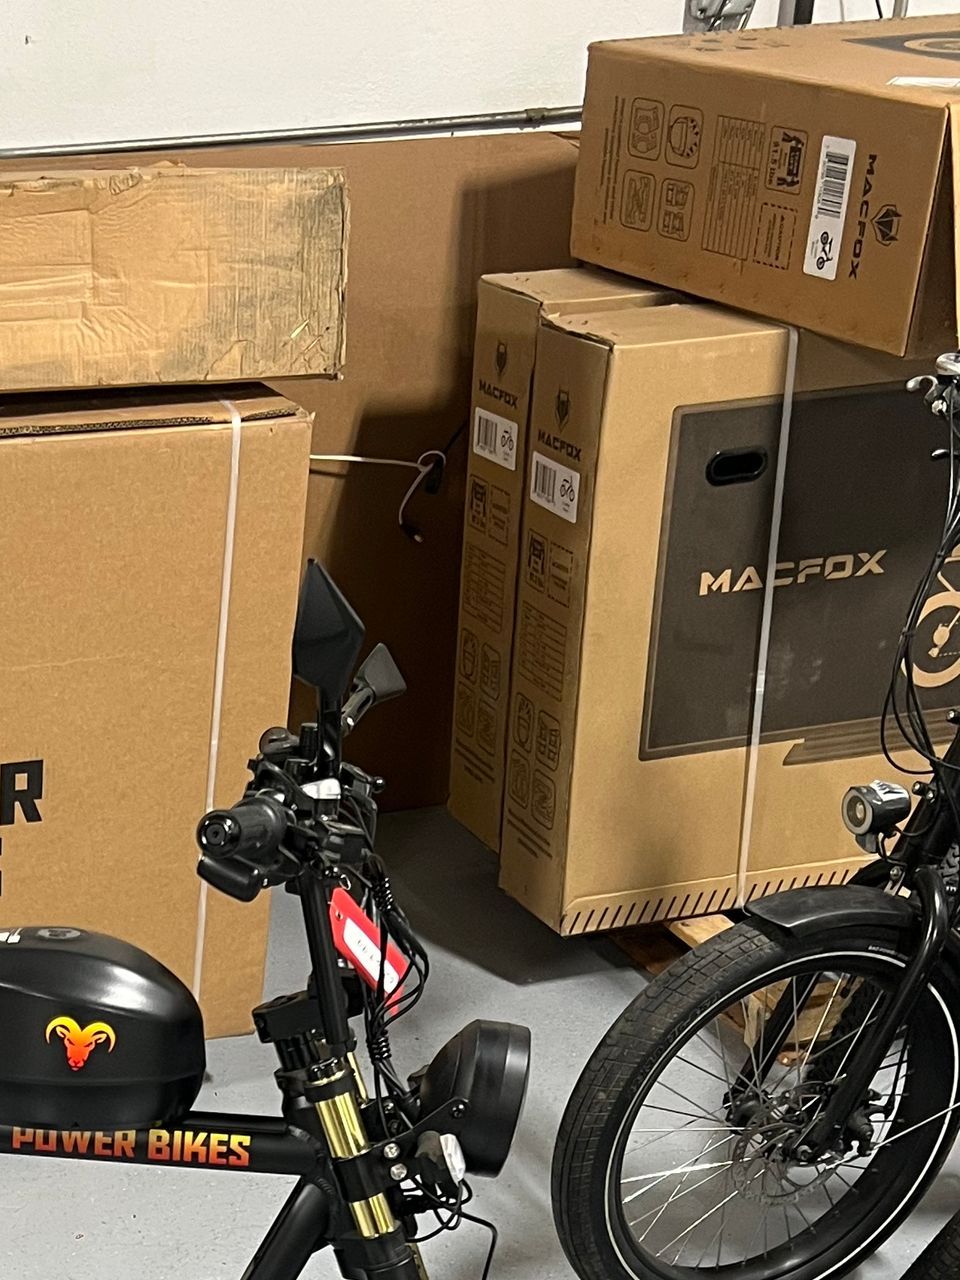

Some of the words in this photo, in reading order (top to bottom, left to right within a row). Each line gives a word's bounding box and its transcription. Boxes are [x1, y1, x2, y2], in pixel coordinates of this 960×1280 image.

[848, 154, 878, 280] MACFOX
[478, 379, 519, 409] MACFOX
[537, 428, 582, 462] MACFOX
[698, 549, 888, 597] MACFOX
[12, 1126, 137, 1158] POWER
[147, 1128, 251, 1167] BIKES
